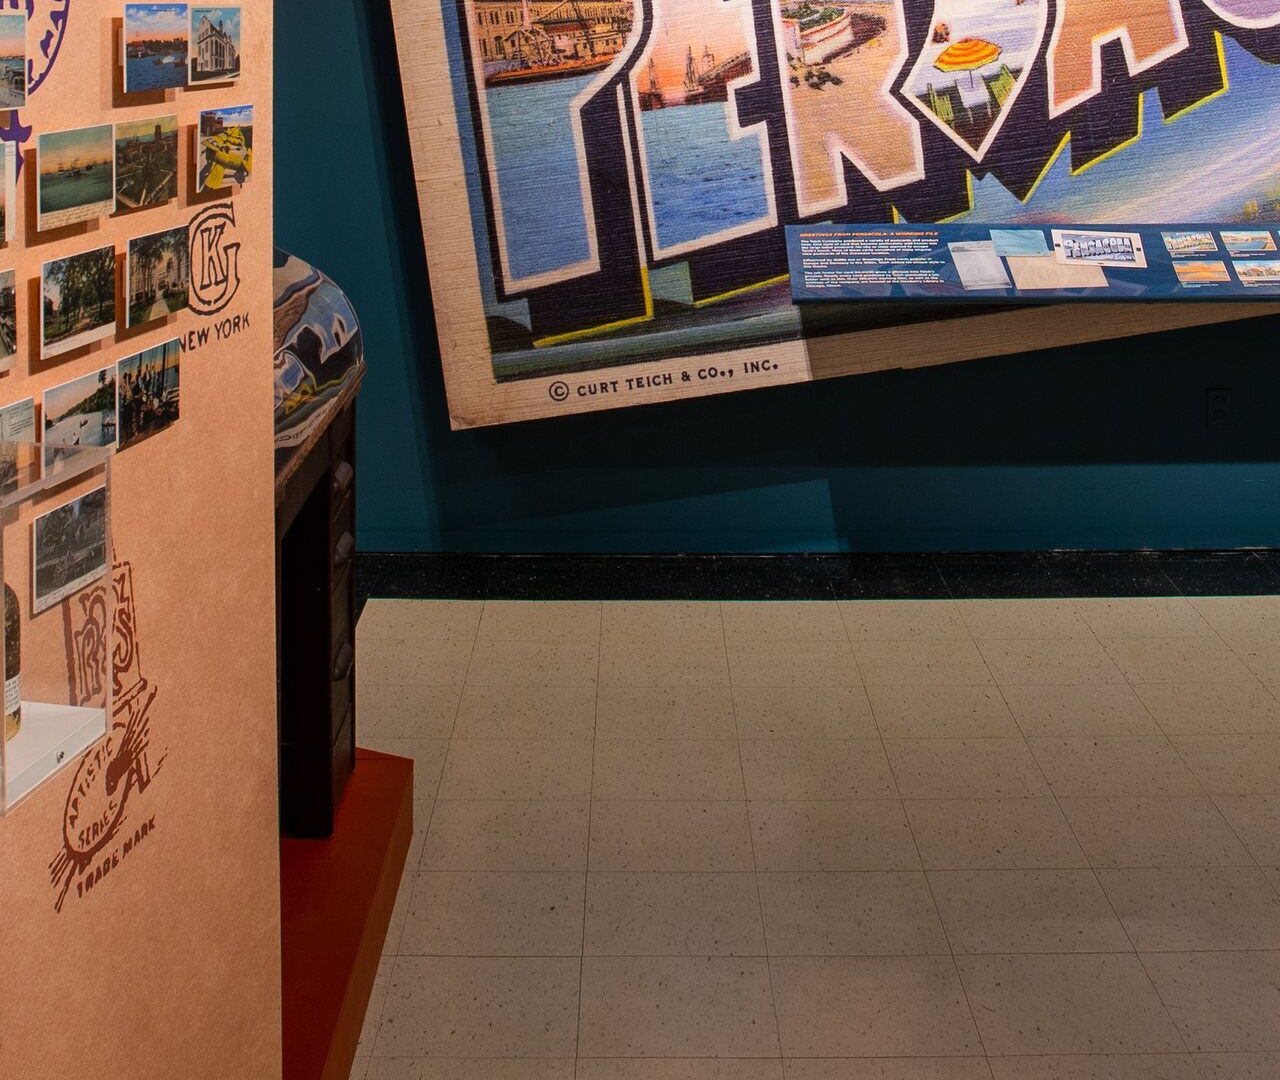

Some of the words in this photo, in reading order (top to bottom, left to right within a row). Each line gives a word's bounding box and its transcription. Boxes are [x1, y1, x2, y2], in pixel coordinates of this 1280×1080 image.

[179, 326, 210, 354] NEW
[576, 380, 619, 397] CURT
[625, 372, 673, 391] TEICH
[681, 370, 691, 382] &
[697, 366, 734, 380] CO.,
[743, 358, 779, 375] INC.
[76, 800, 118, 851] SERIES
[76, 855, 119, 899] TRADE
[121, 813, 157, 860] MARK
